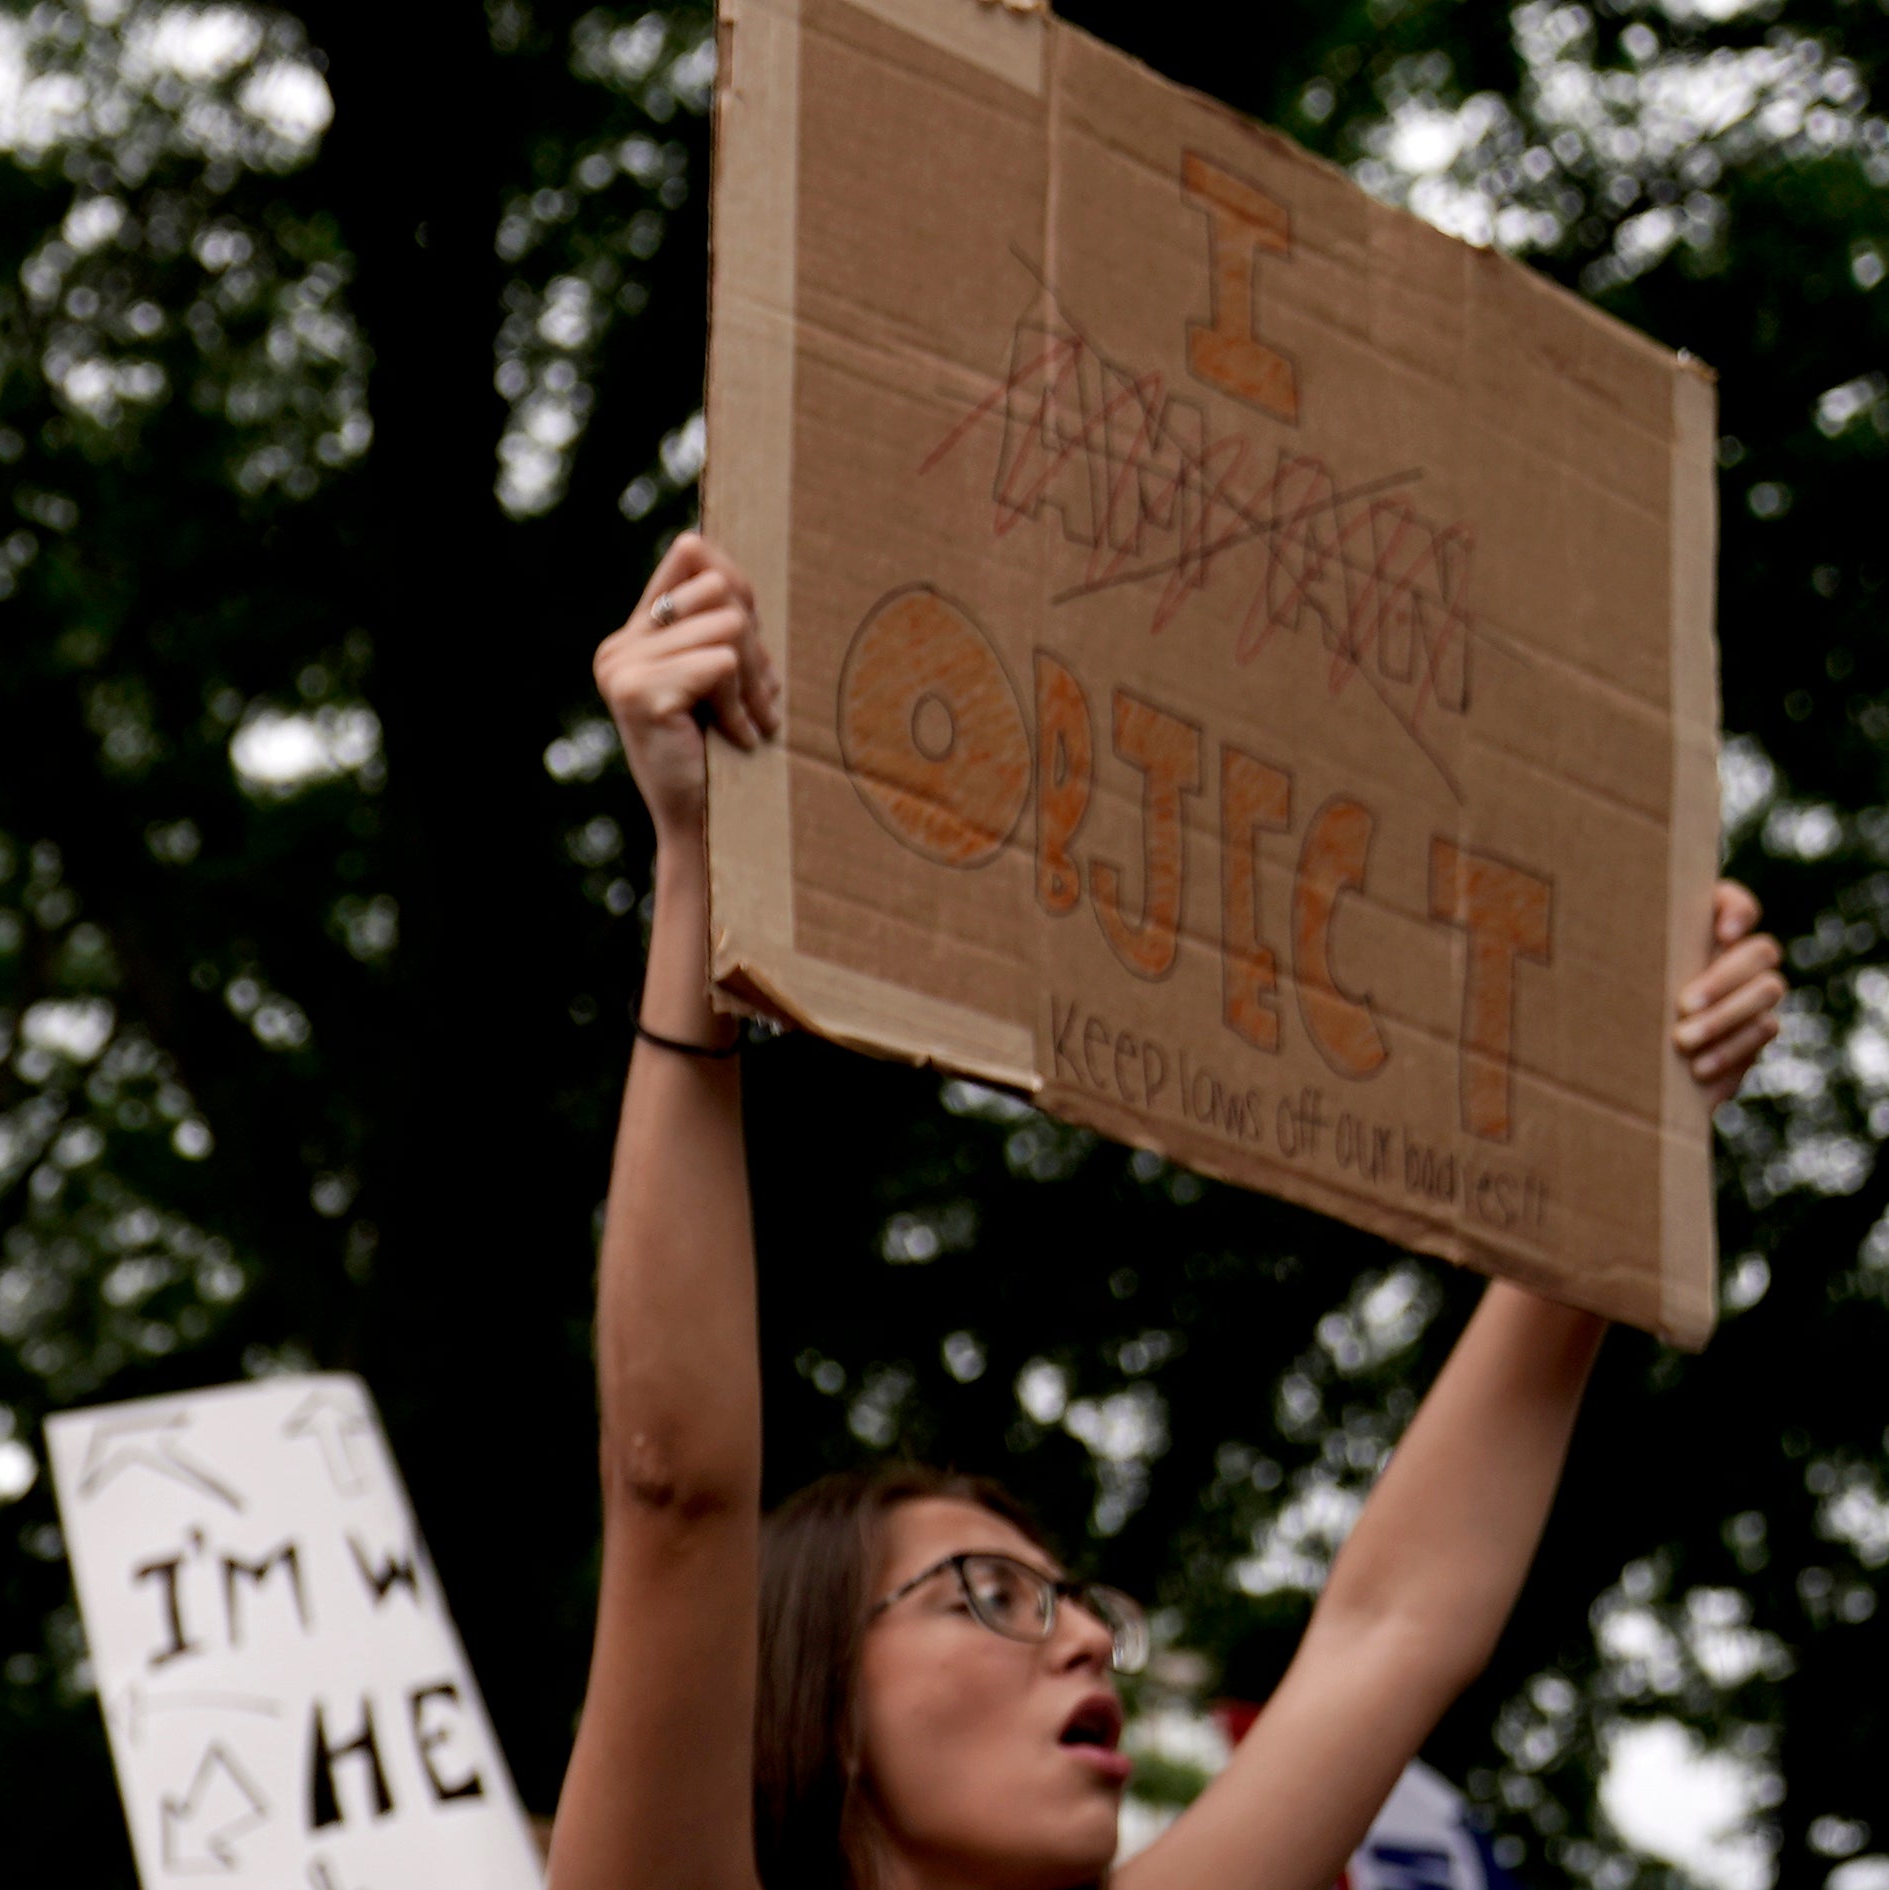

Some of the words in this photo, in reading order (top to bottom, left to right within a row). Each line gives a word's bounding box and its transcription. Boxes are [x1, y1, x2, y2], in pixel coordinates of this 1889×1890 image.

[1179, 147, 1301, 427] I
[835, 580, 1555, 1145] OBJECT
[1047, 996, 1168, 1110] Keep
[132, 1523, 317, 1673] I'M
[304, 1680, 488, 1841] HE
